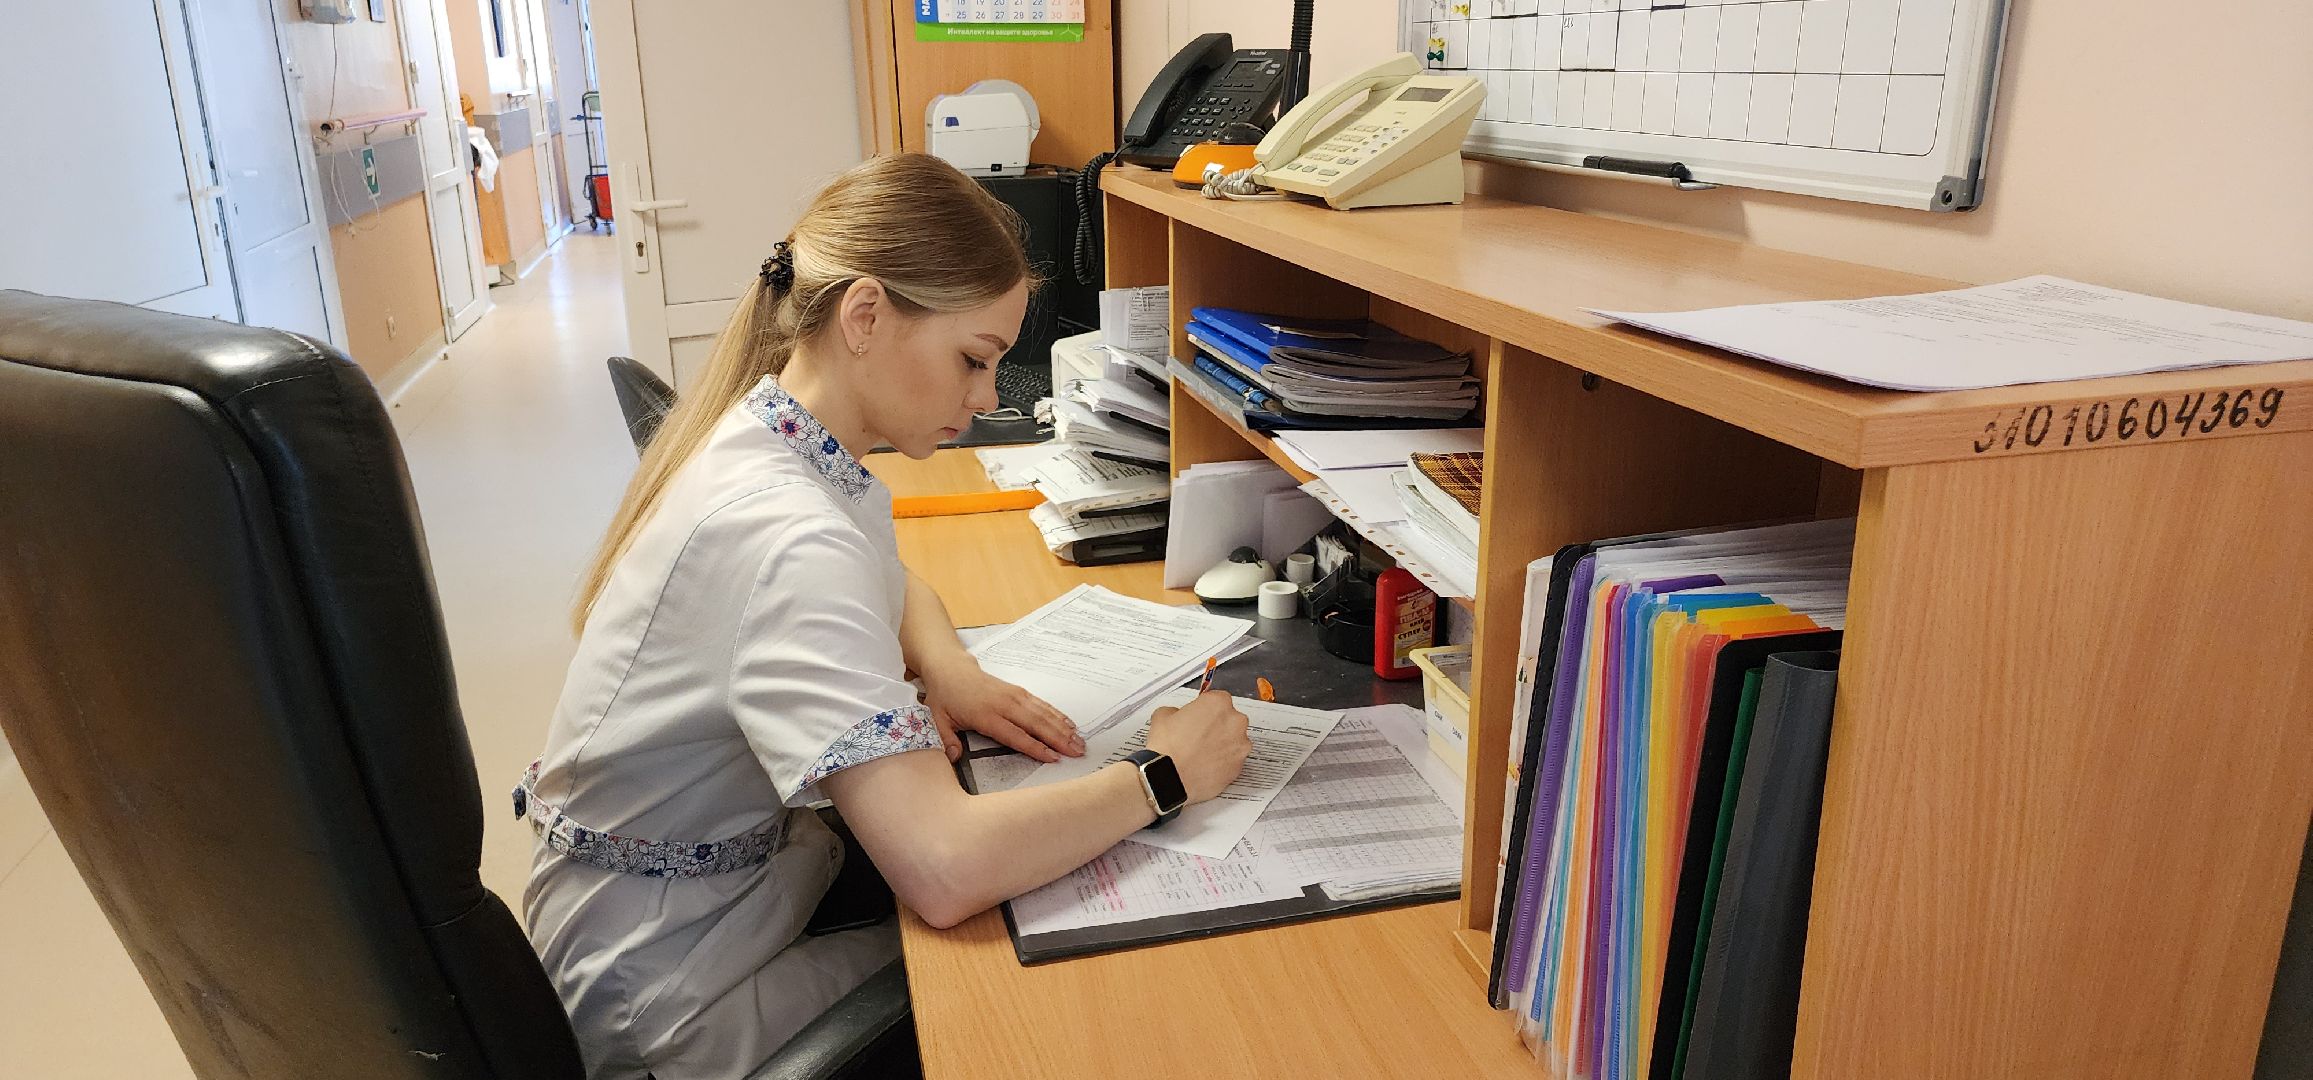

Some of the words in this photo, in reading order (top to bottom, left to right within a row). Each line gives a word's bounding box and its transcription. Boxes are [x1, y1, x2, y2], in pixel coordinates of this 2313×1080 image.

[956, 11, 967, 19] 25
[975, 11, 986, 19] 26
[995, 11, 1005, 19] 27
[1013, 11, 1024, 19] 28
[1032, 11, 1043, 19] 29
[1051, 11, 1062, 19] 30
[1071, 11, 1080, 19] 31
[947, 28, 985, 36] Интеллект
[995, 29, 1021, 37] защите
[1022, 29, 1053, 37] здоровья
